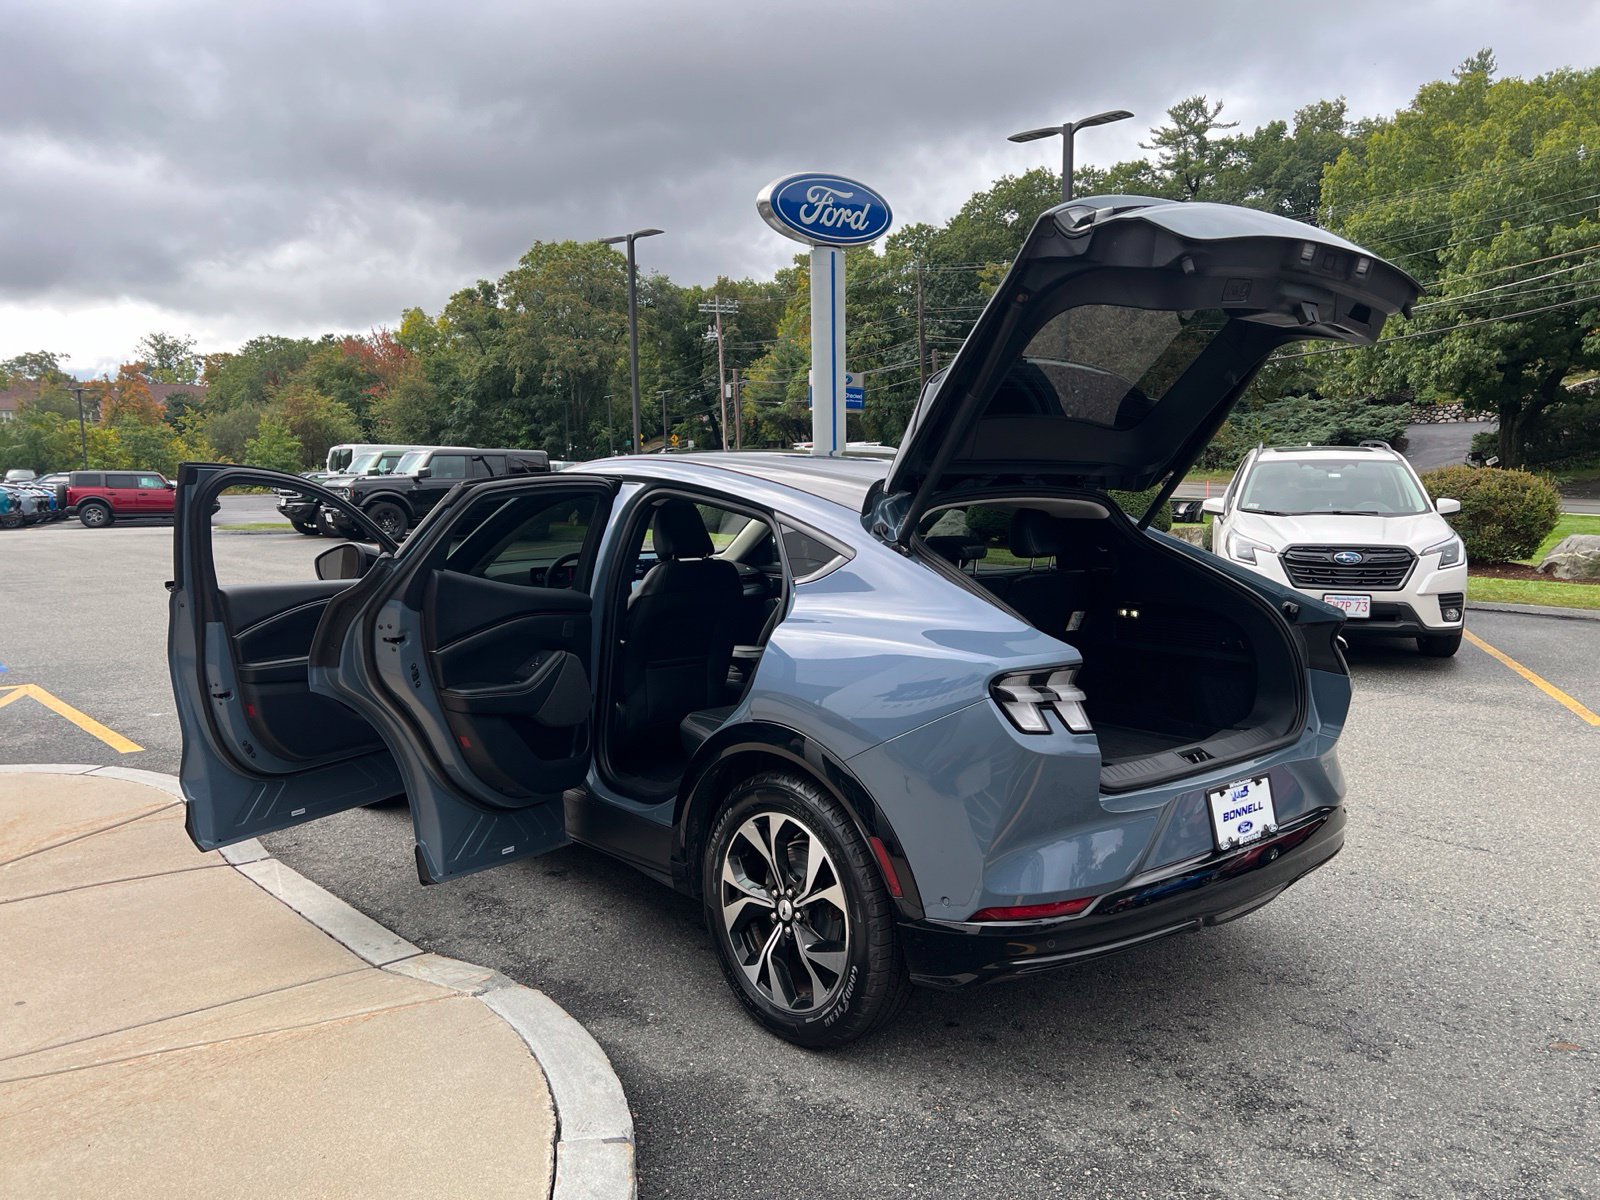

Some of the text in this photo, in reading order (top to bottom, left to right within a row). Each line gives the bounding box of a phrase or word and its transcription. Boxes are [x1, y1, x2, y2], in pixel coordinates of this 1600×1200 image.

[799, 185, 871, 231] Ford
[1354, 601, 1368, 613] 73
[1223, 801, 1263, 823] BONNELL
[823, 965, 859, 1028] GOODYEAR
